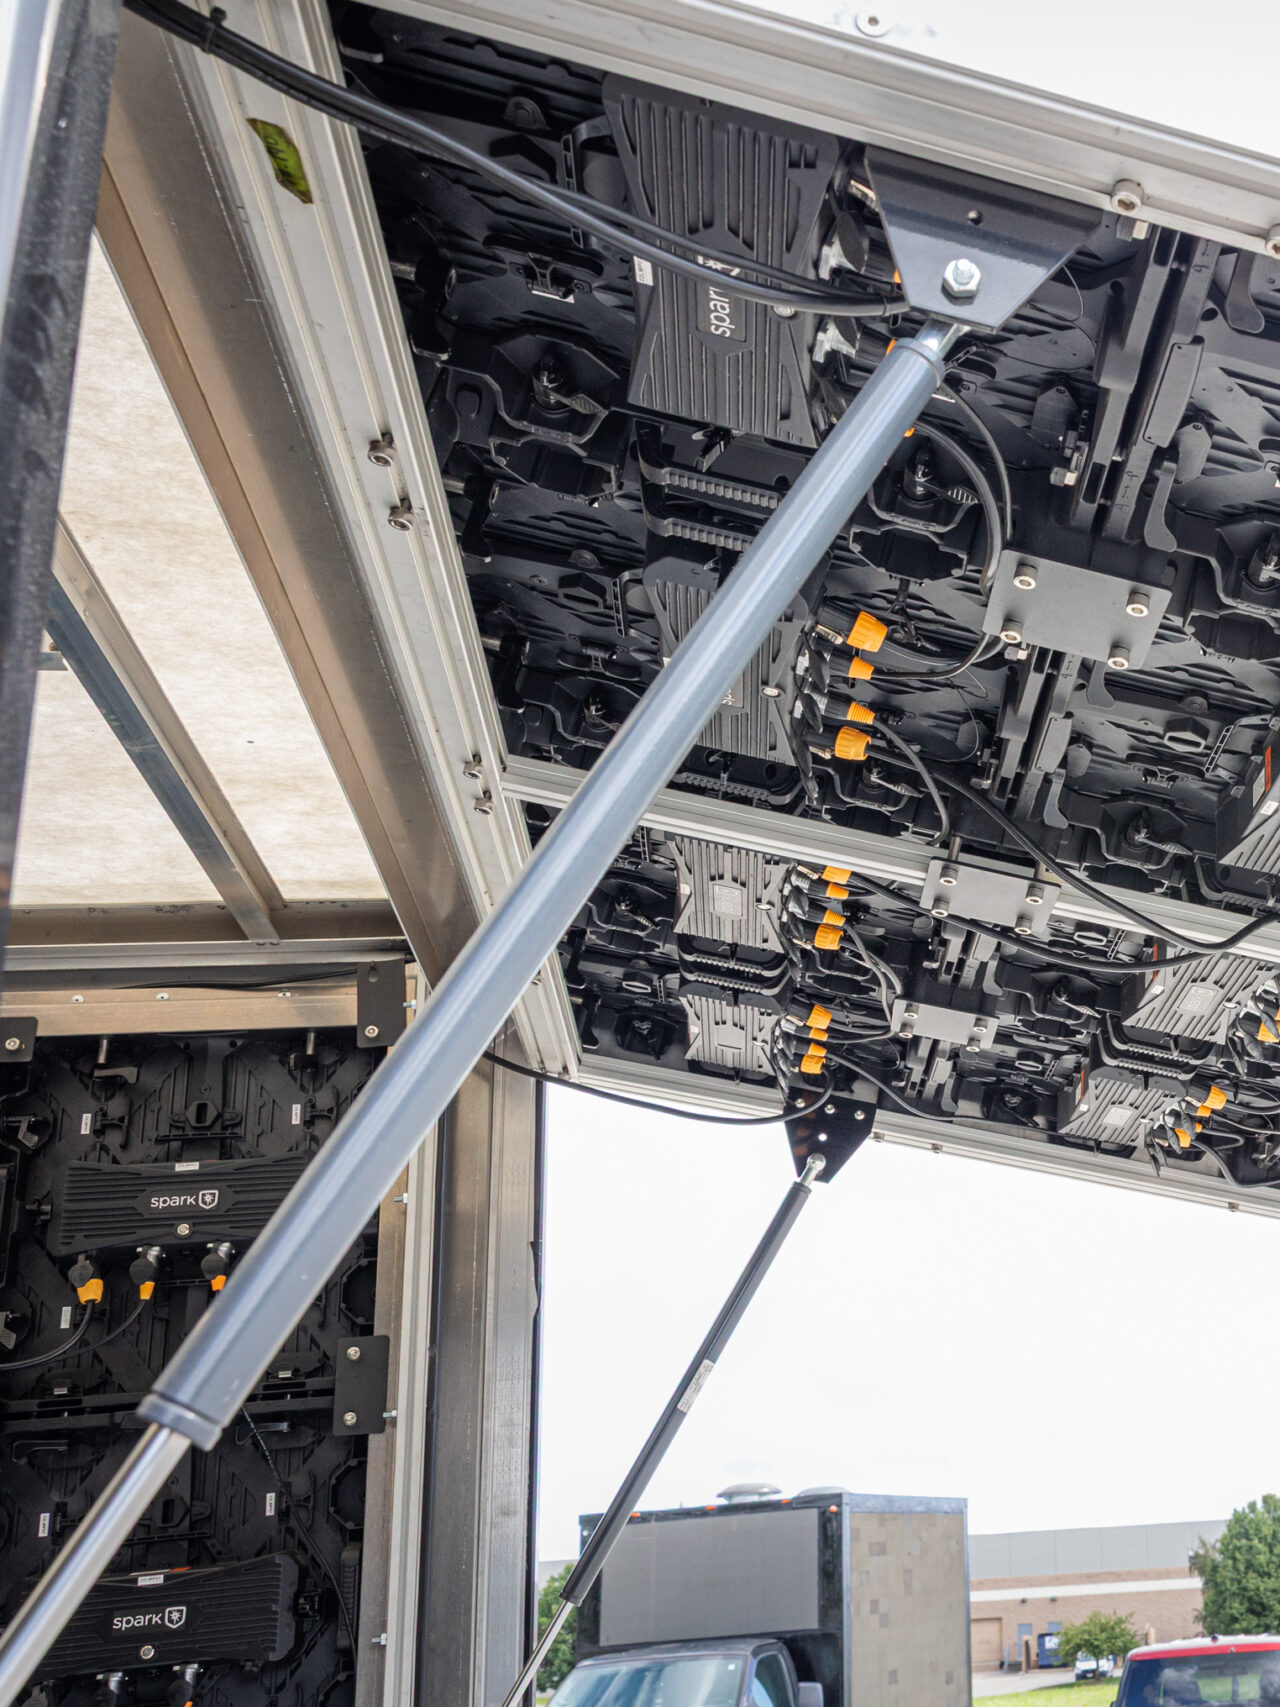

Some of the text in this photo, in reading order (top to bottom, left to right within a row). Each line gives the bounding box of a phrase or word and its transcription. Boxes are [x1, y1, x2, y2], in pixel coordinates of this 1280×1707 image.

[709, 286, 736, 338] spar
[150, 1194, 197, 1210] spark
[112, 1613, 163, 1631] spark
